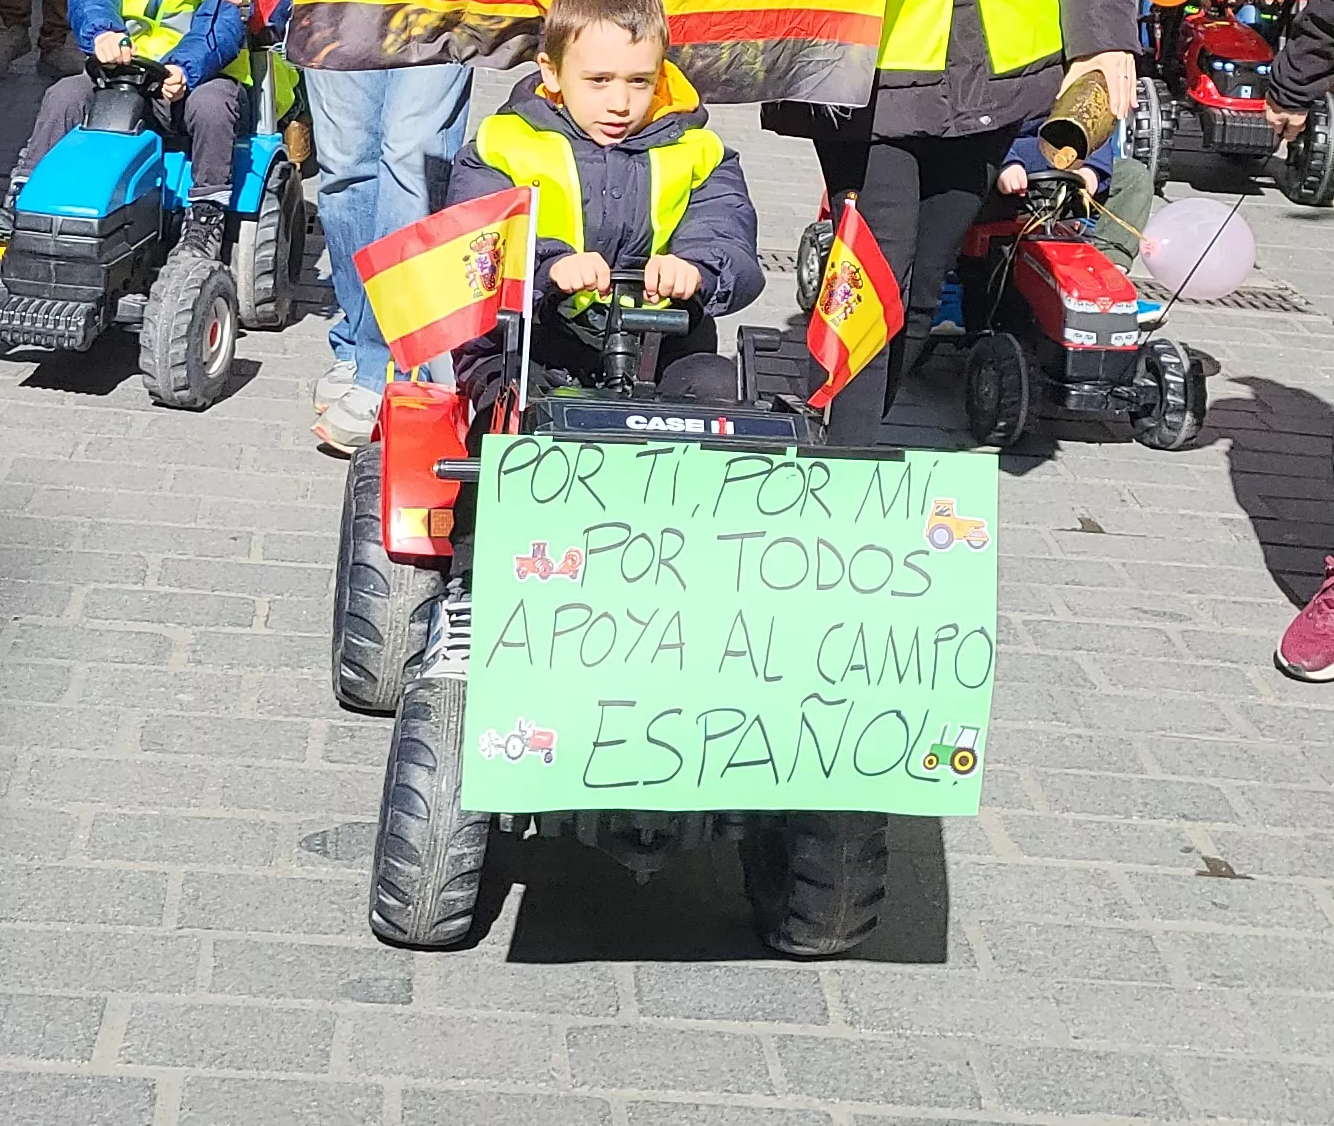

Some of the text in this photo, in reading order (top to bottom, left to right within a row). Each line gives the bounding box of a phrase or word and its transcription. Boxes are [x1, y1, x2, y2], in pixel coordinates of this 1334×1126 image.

[625, 415, 705, 433] CASE
[497, 437, 606, 511] POR
[712, 455, 832, 519] POR
[580, 522, 932, 598] POR TODOS
[485, 598, 993, 690] APOYA AL CAMPO
